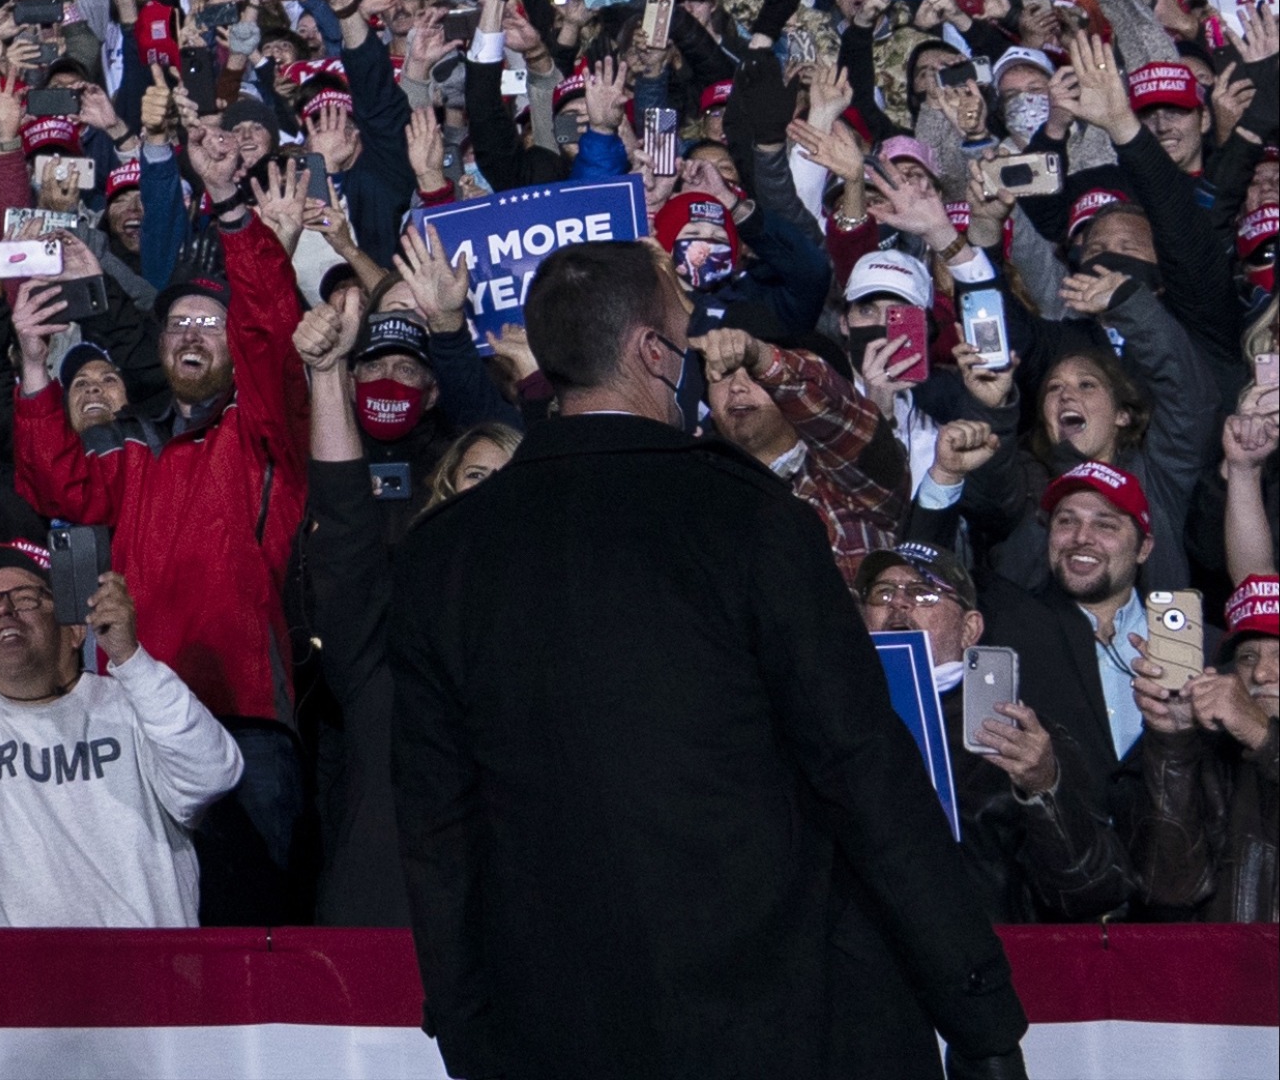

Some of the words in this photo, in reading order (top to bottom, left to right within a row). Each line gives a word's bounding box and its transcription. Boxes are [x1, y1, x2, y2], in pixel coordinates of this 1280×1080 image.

[1150, 66, 1191, 80] AMERICA
[1134, 80, 1158, 95] GREAT
[1158, 79, 1187, 91] AGAIN
[450, 239, 479, 271] 4
[487, 212, 614, 267] MORE
[868, 263, 914, 276] TRUMP
[366, 398, 411, 413] TRUMP
[1244, 580, 1280, 599] AMER
[1253, 599, 1280, 616] AGA
